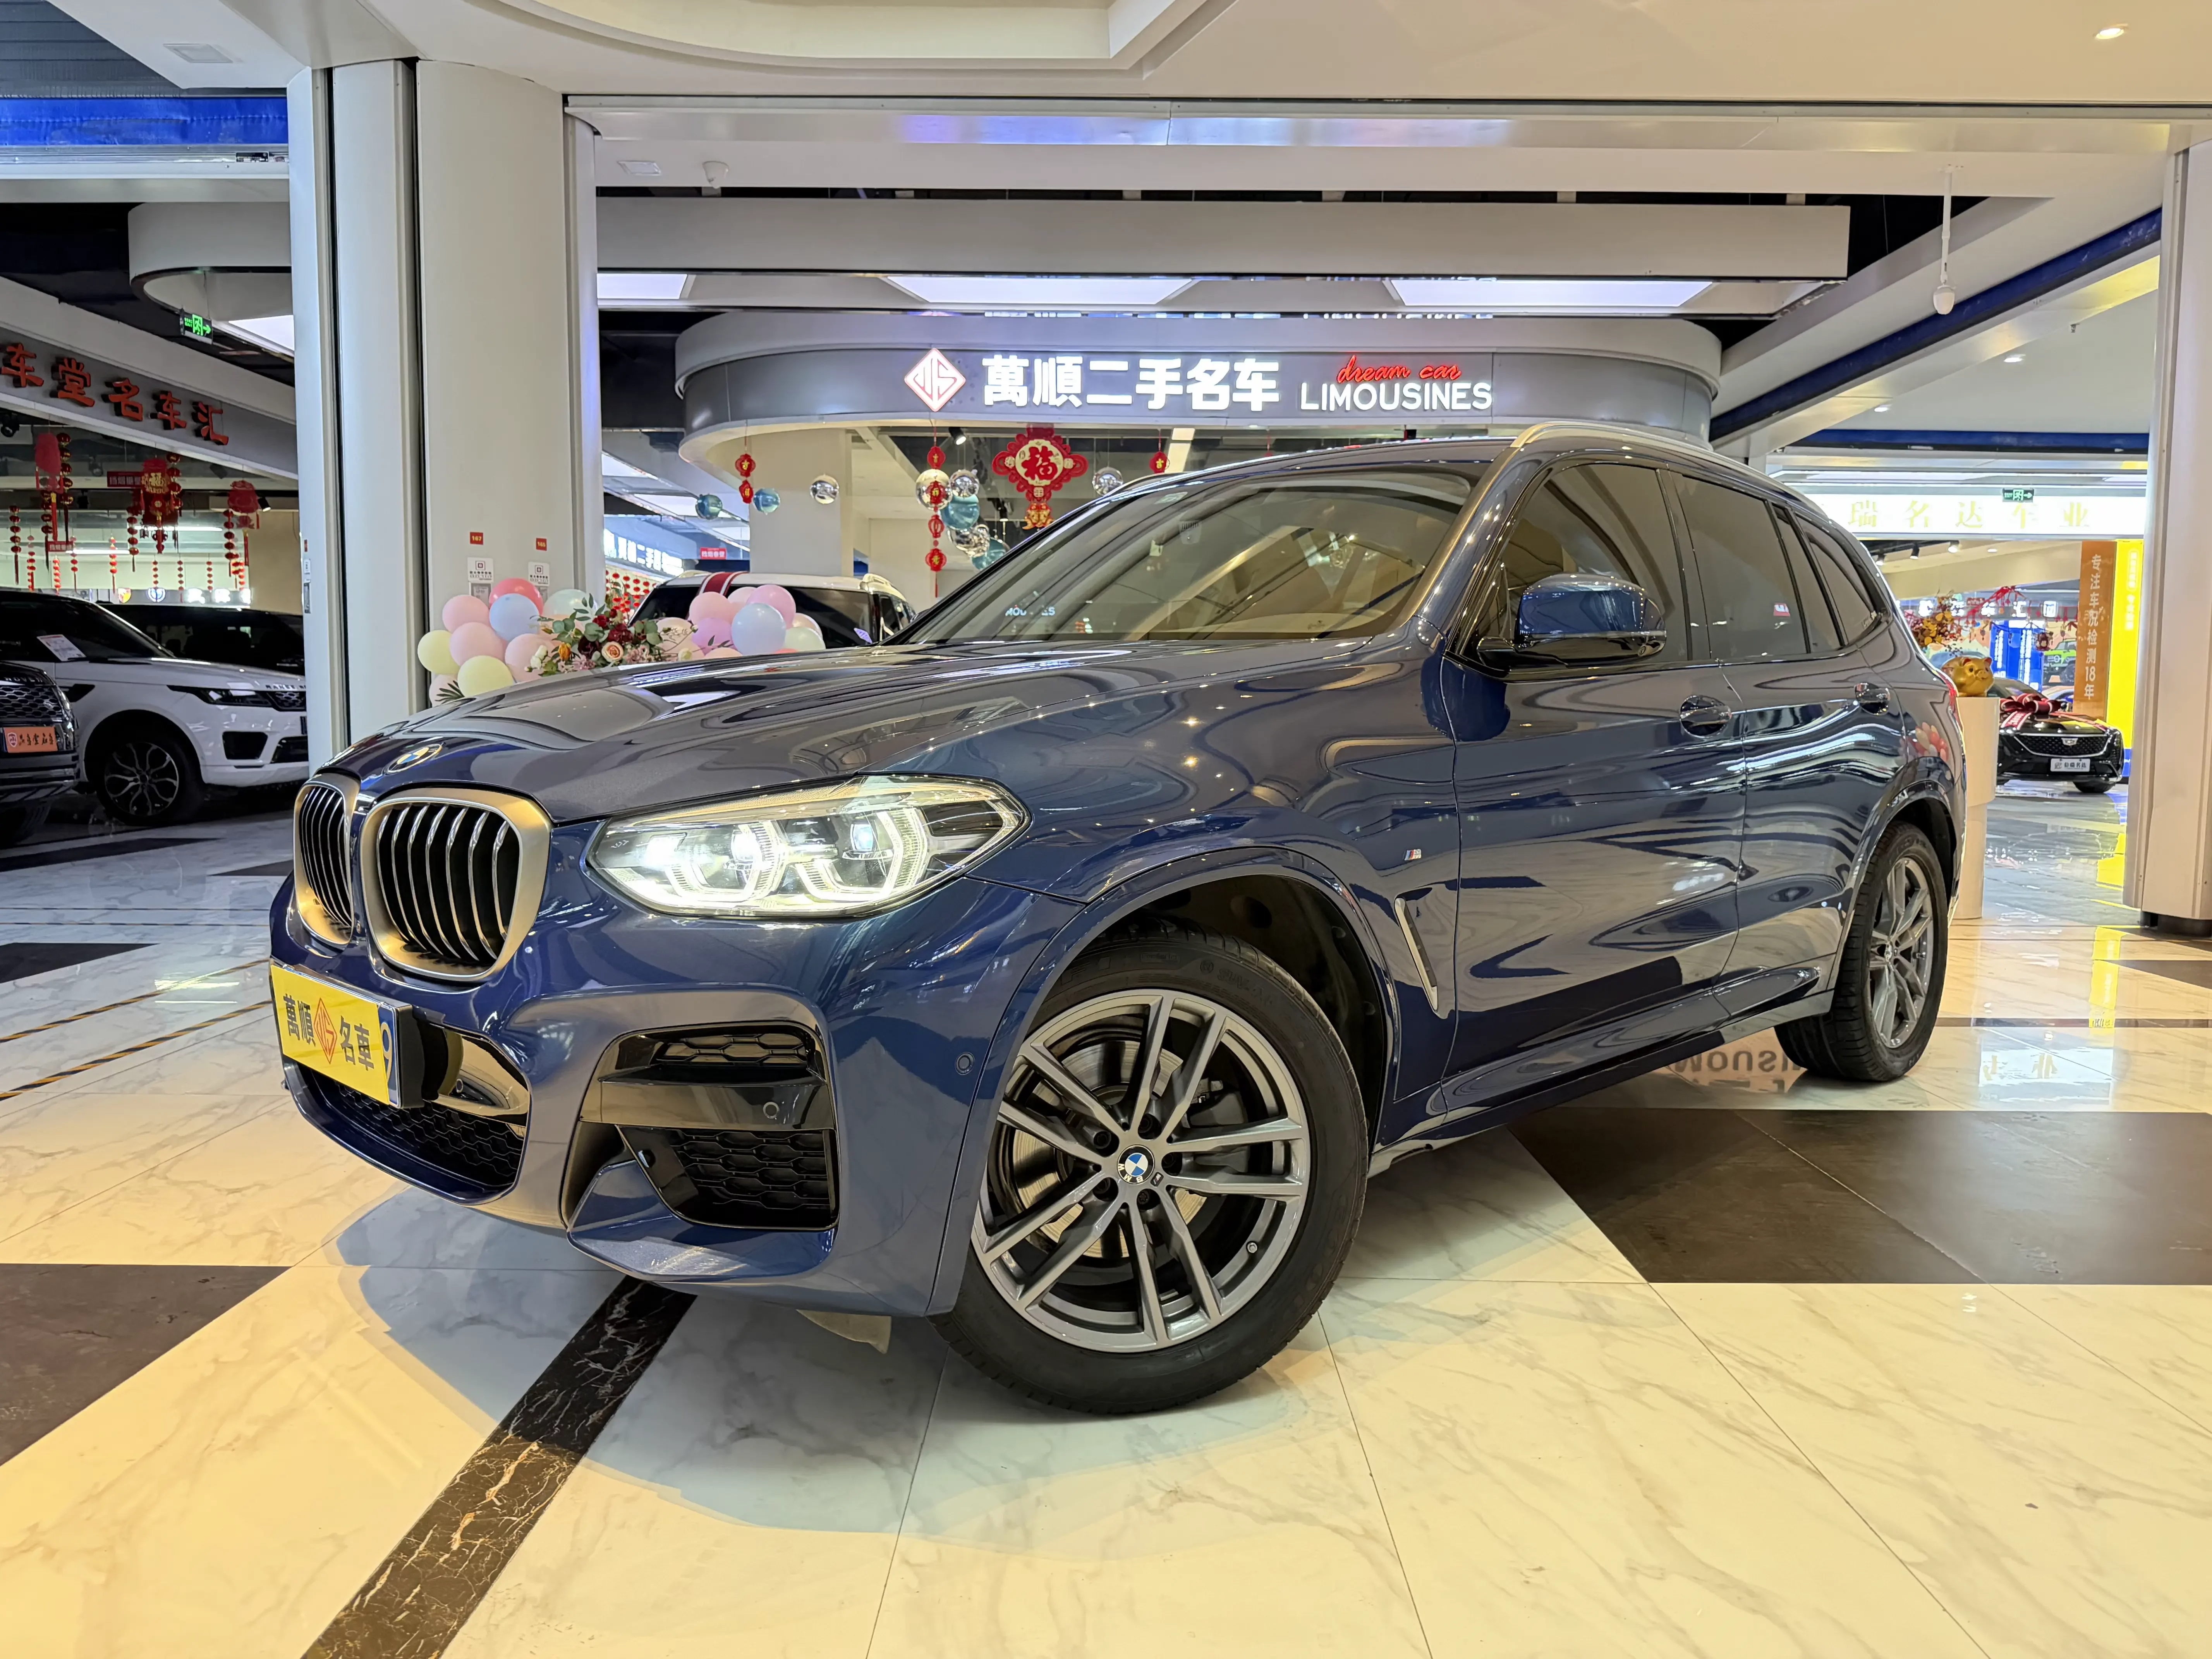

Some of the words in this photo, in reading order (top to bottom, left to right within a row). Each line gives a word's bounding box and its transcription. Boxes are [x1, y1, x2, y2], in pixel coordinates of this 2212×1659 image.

[1, 342, 229, 445] 车堂名车汇
[982, 354, 1279, 411] 萬順二手名车
[1300, 382, 1492, 411] LIMOUSINES
[1337, 355, 1412, 383] dream
[1419, 365, 1462, 380] car
[1021, 446, 1058, 480] 福
[2084, 554, 2102, 700] 专注车况检测18年
[283, 993, 316, 1047] 萬順
[340, 1015, 374, 1071] 名車
